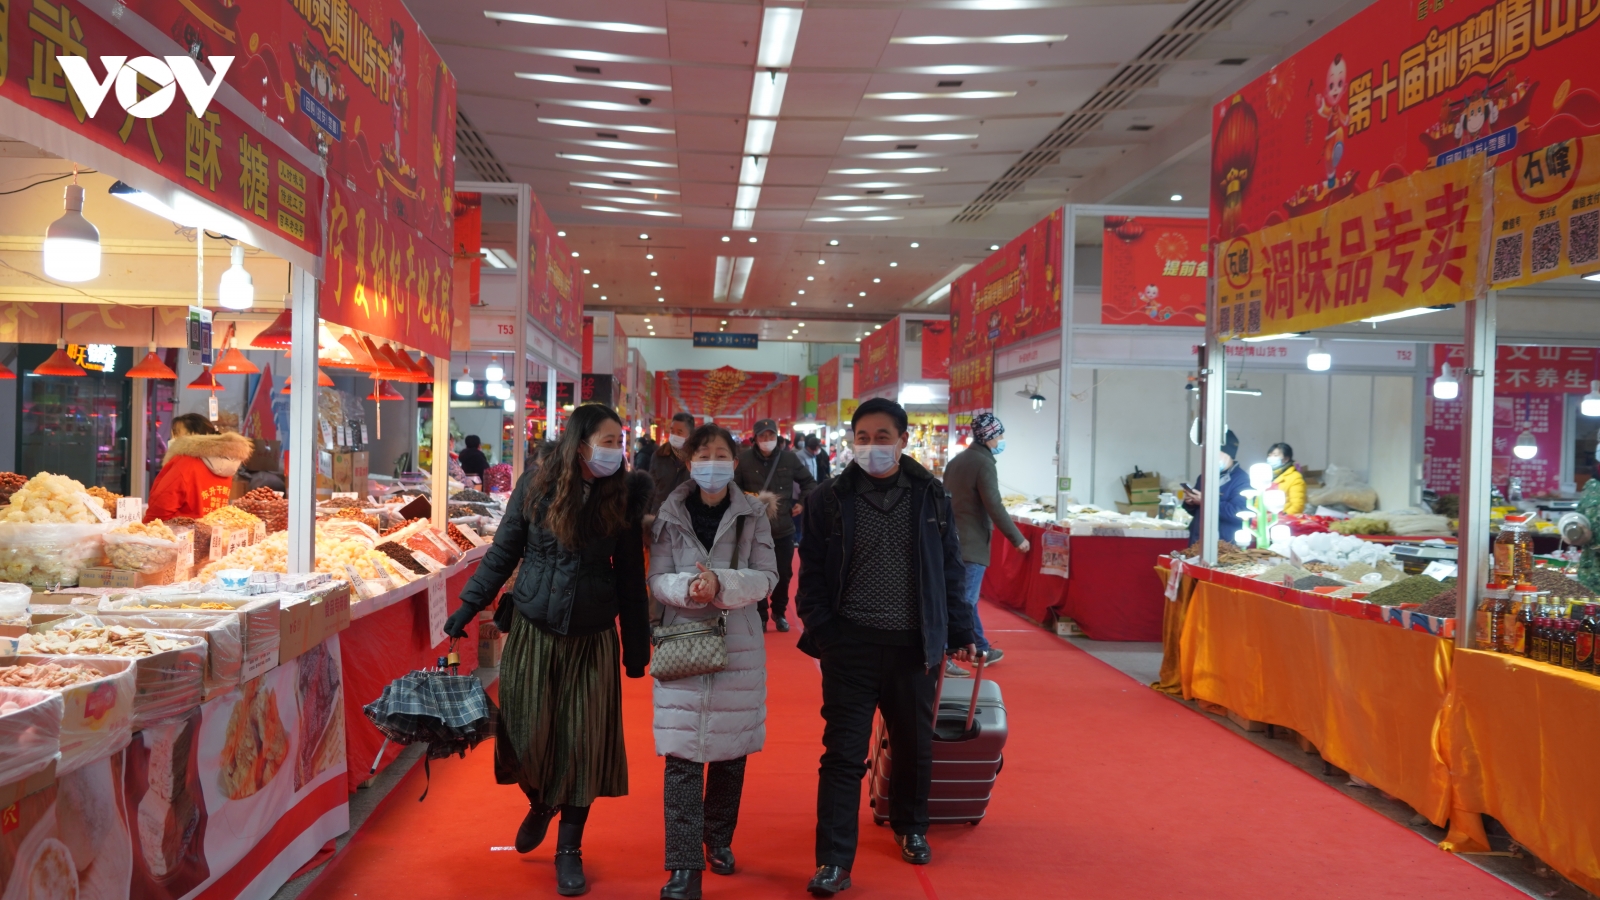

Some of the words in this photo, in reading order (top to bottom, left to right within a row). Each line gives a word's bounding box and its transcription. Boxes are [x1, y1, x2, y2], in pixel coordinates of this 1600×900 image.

[1348, 0, 1600, 138] 第十届荆楚情山
[1262, 184, 1469, 320] 调味品专卖
[498, 324, 514, 335] T53
[1397, 351, 1412, 361] T52
